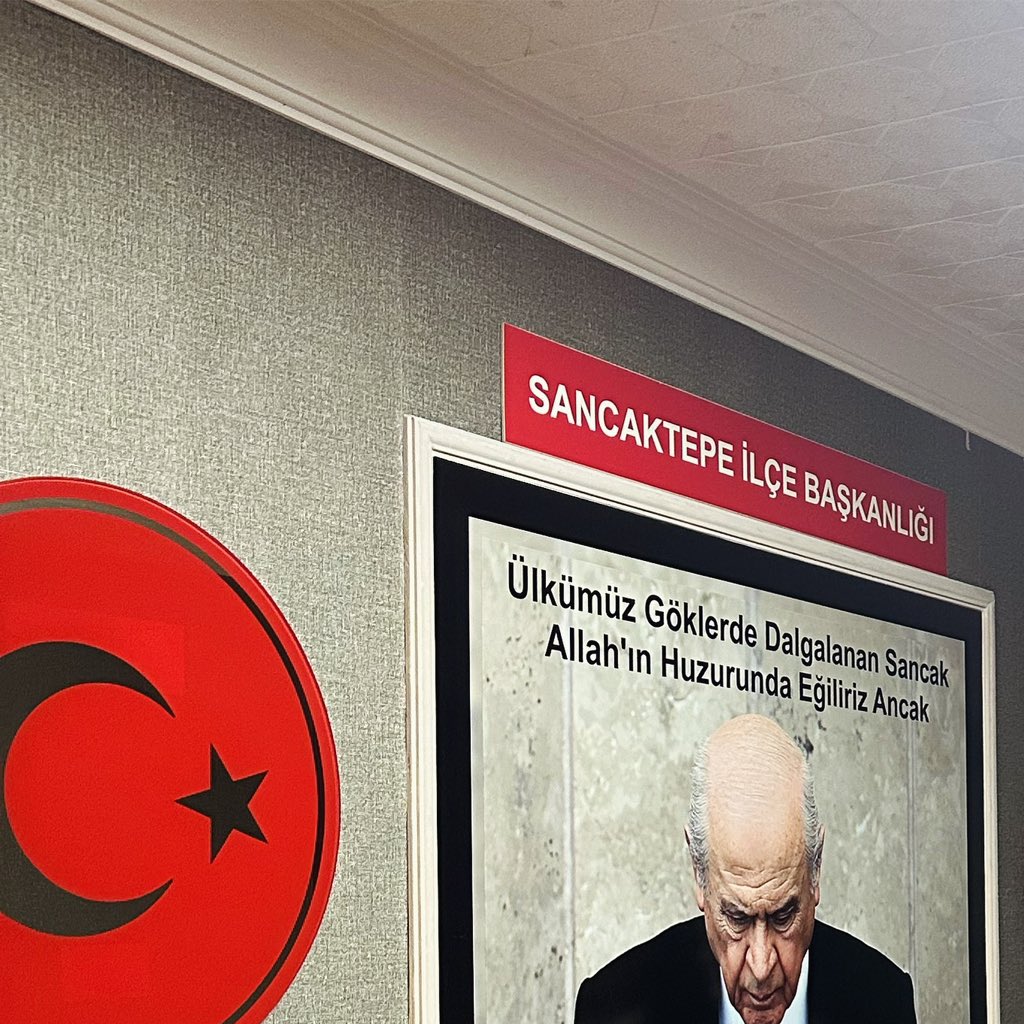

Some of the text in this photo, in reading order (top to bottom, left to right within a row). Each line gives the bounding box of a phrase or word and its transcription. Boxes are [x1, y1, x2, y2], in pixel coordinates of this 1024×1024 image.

[528, 375, 934, 544] SANCAKTEPE İLÇE BAŞKANLIĞI
[508, 554, 949, 688] Ülkümüz Göklerde Dalgalanan Sancak
[545, 624, 929, 723] Allah'ın Huzurunda Eğiliriz Ancak
